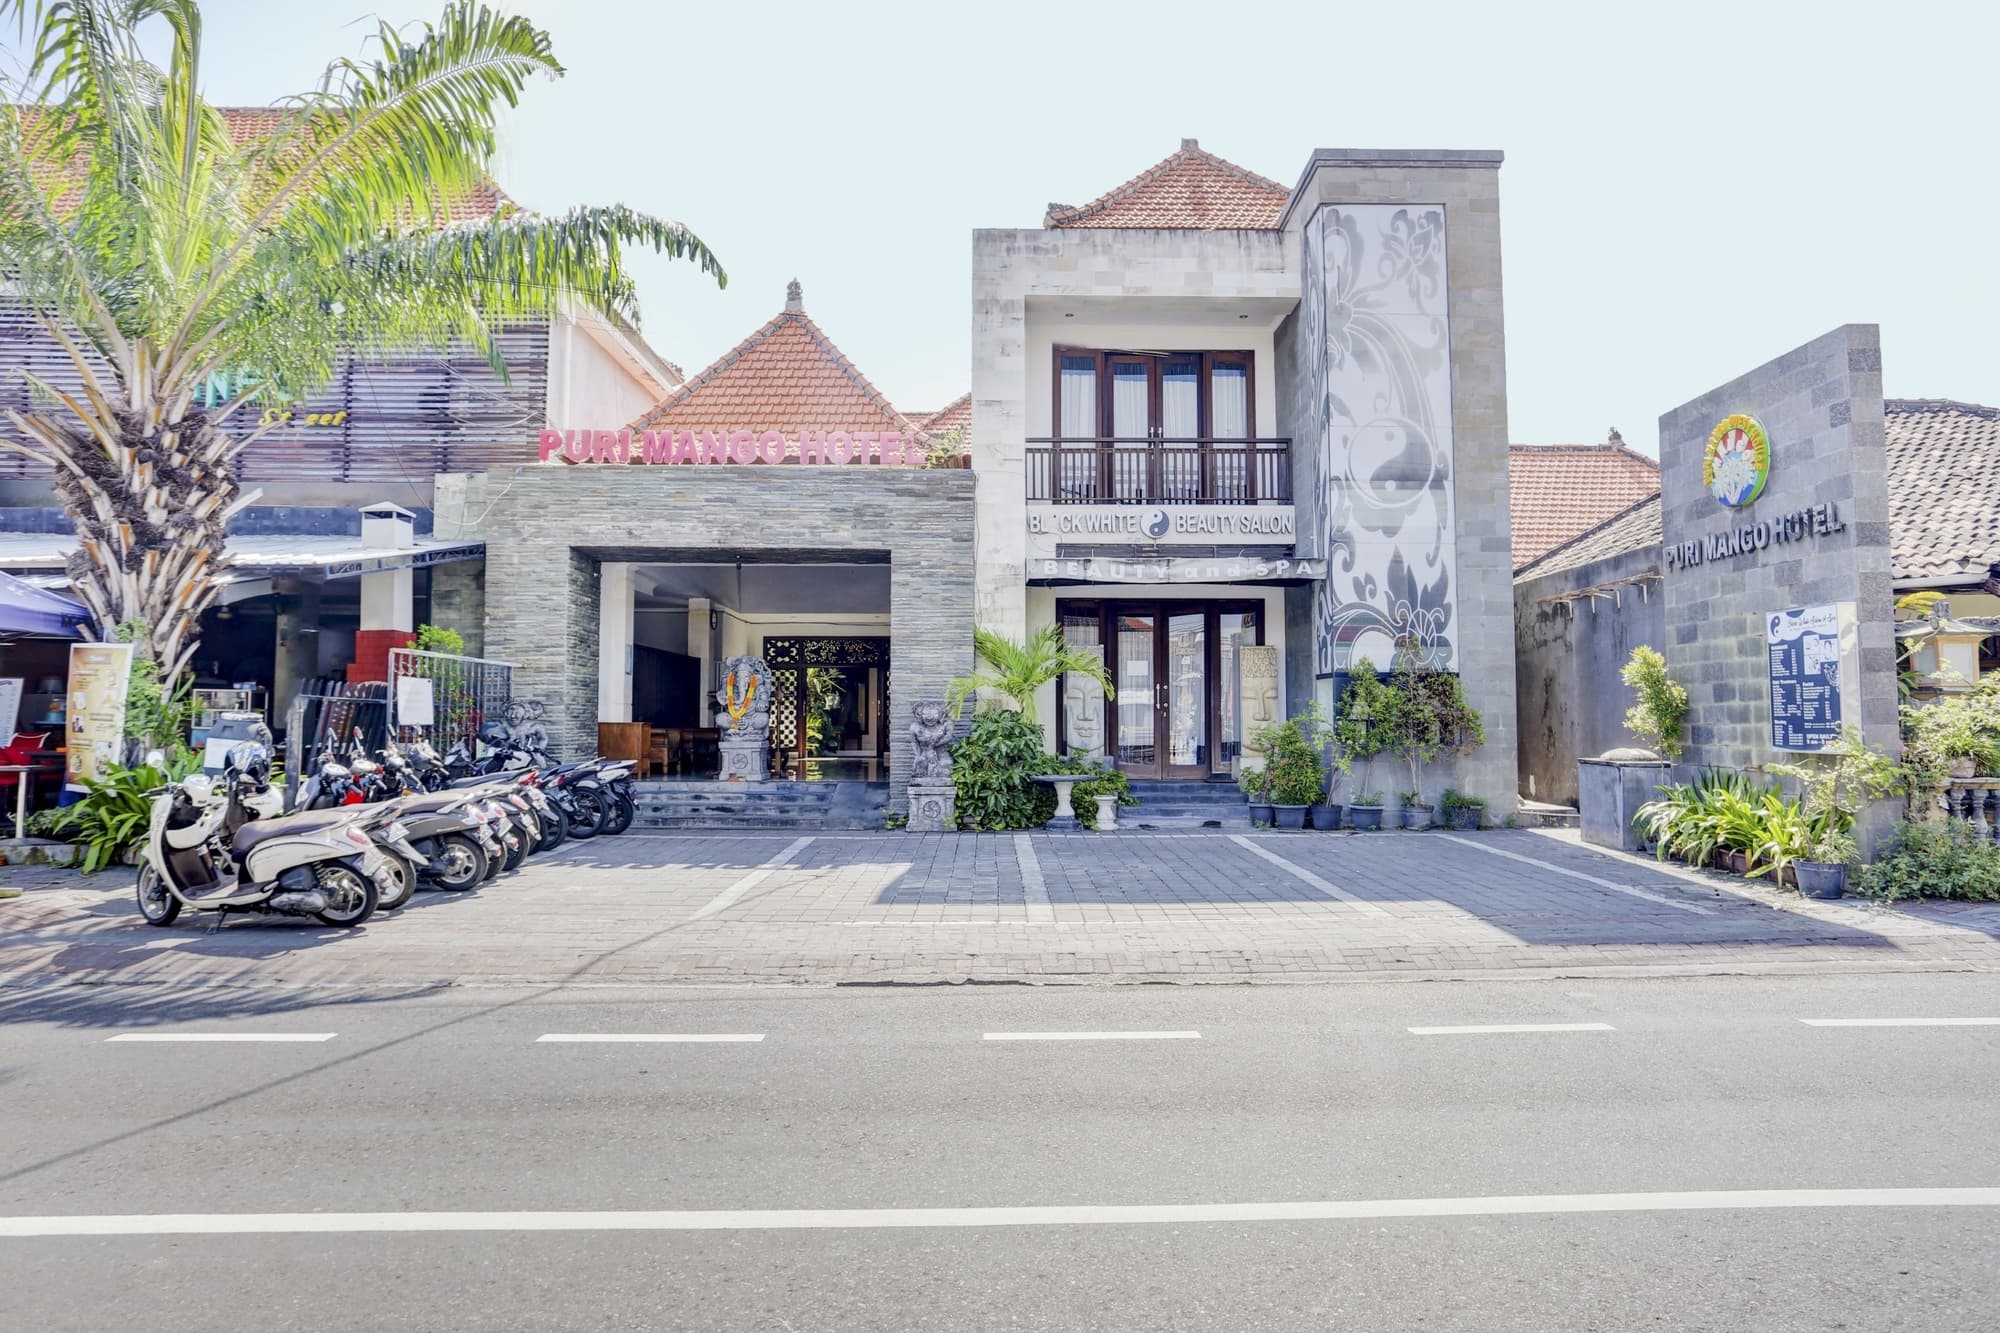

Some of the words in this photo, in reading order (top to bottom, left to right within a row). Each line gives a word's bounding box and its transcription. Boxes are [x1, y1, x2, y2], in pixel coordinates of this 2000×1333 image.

[258, 408, 347, 427] Steet
[538, 429, 630, 464] PURI
[642, 430, 786, 465] MANGO
[800, 431, 927, 465] HOTEL
[1029, 513, 1082, 534] BLCK
[1085, 513, 1138, 534] WHITE
[1176, 513, 1238, 535] BEAUTY
[1239, 513, 1294, 535] SALON
[1663, 540, 1702, 572] PURI
[1704, 522, 1769, 562] MANGO
[1769, 501, 1846, 546] HOTEL
[1043, 560, 1169, 580] BEAUTY
[1184, 563, 1241, 578] and
[1255, 559, 1313, 577] SPA
